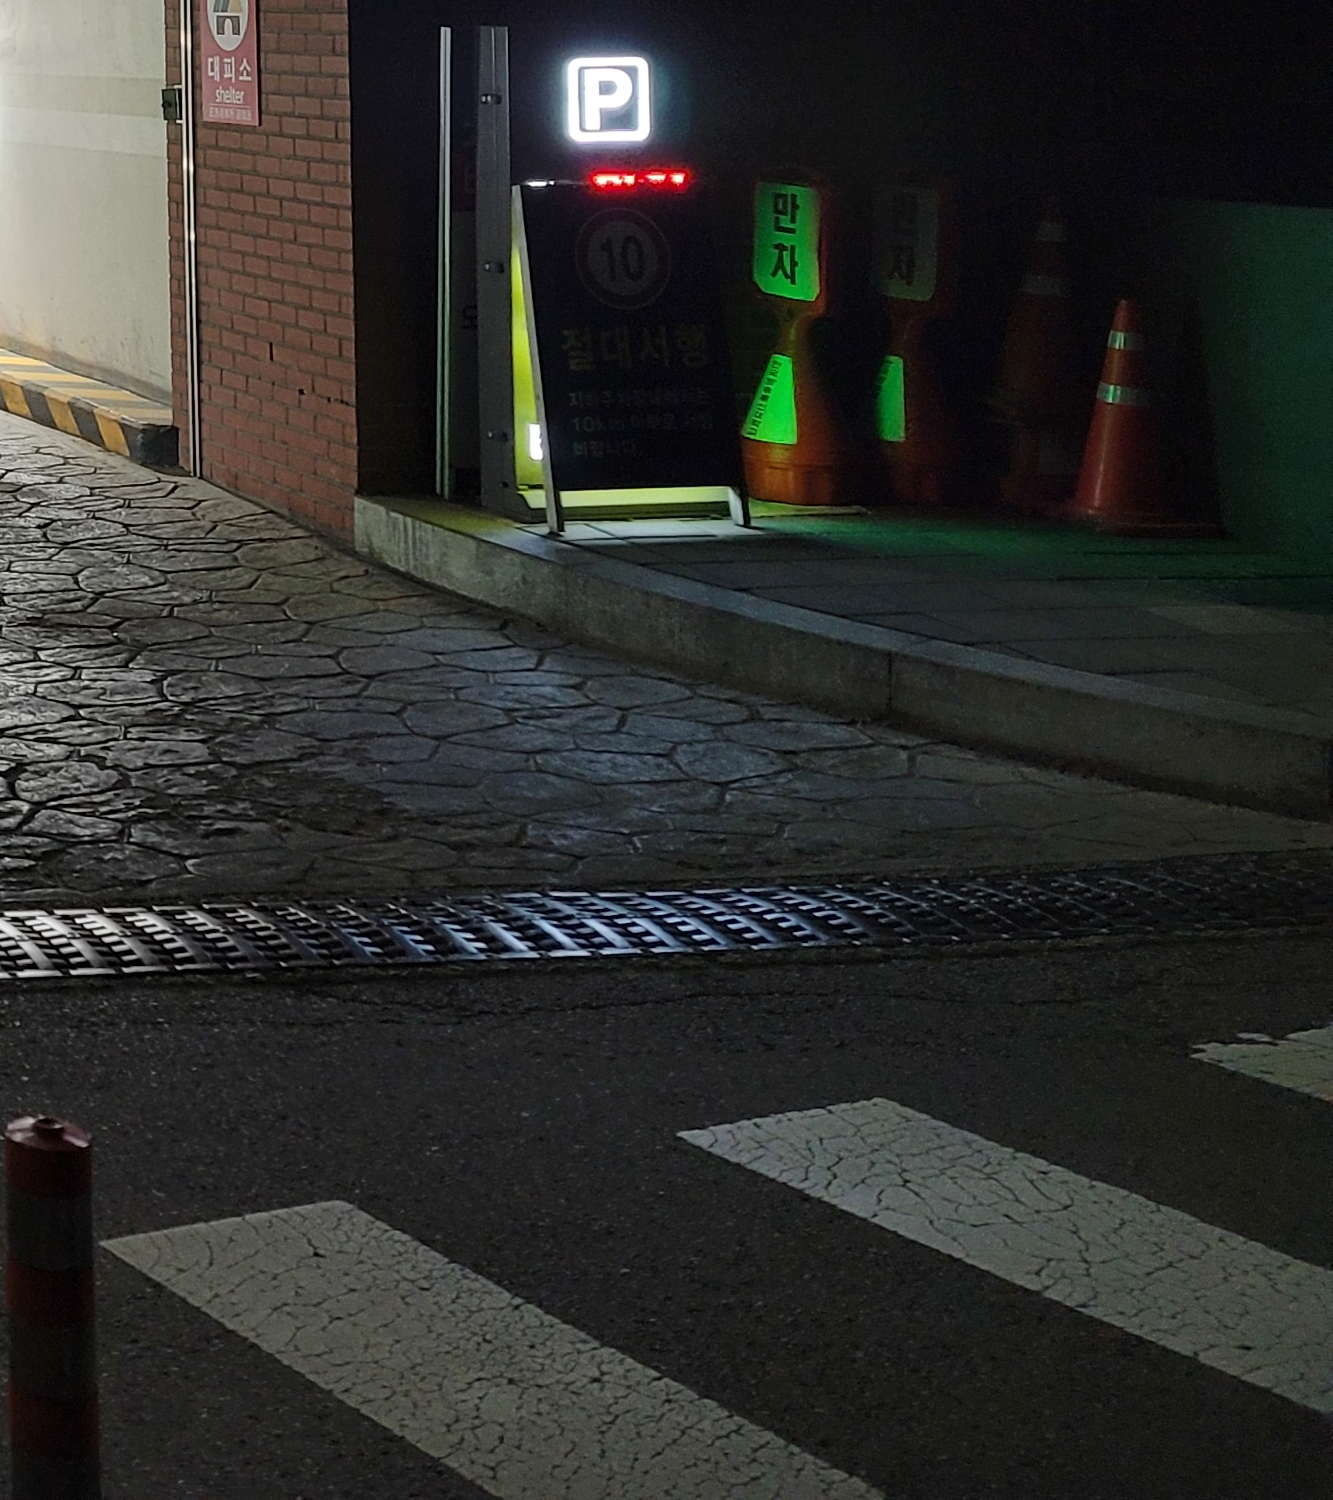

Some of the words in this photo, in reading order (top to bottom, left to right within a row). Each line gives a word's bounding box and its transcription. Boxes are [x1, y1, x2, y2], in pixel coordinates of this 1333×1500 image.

[207, 55, 253, 83] 대피소
[215, 84, 245, 104] shelter
[599, 234, 645, 282] 10
[770, 192, 800, 286] 만차
[560, 323, 711, 372] 절대서행
